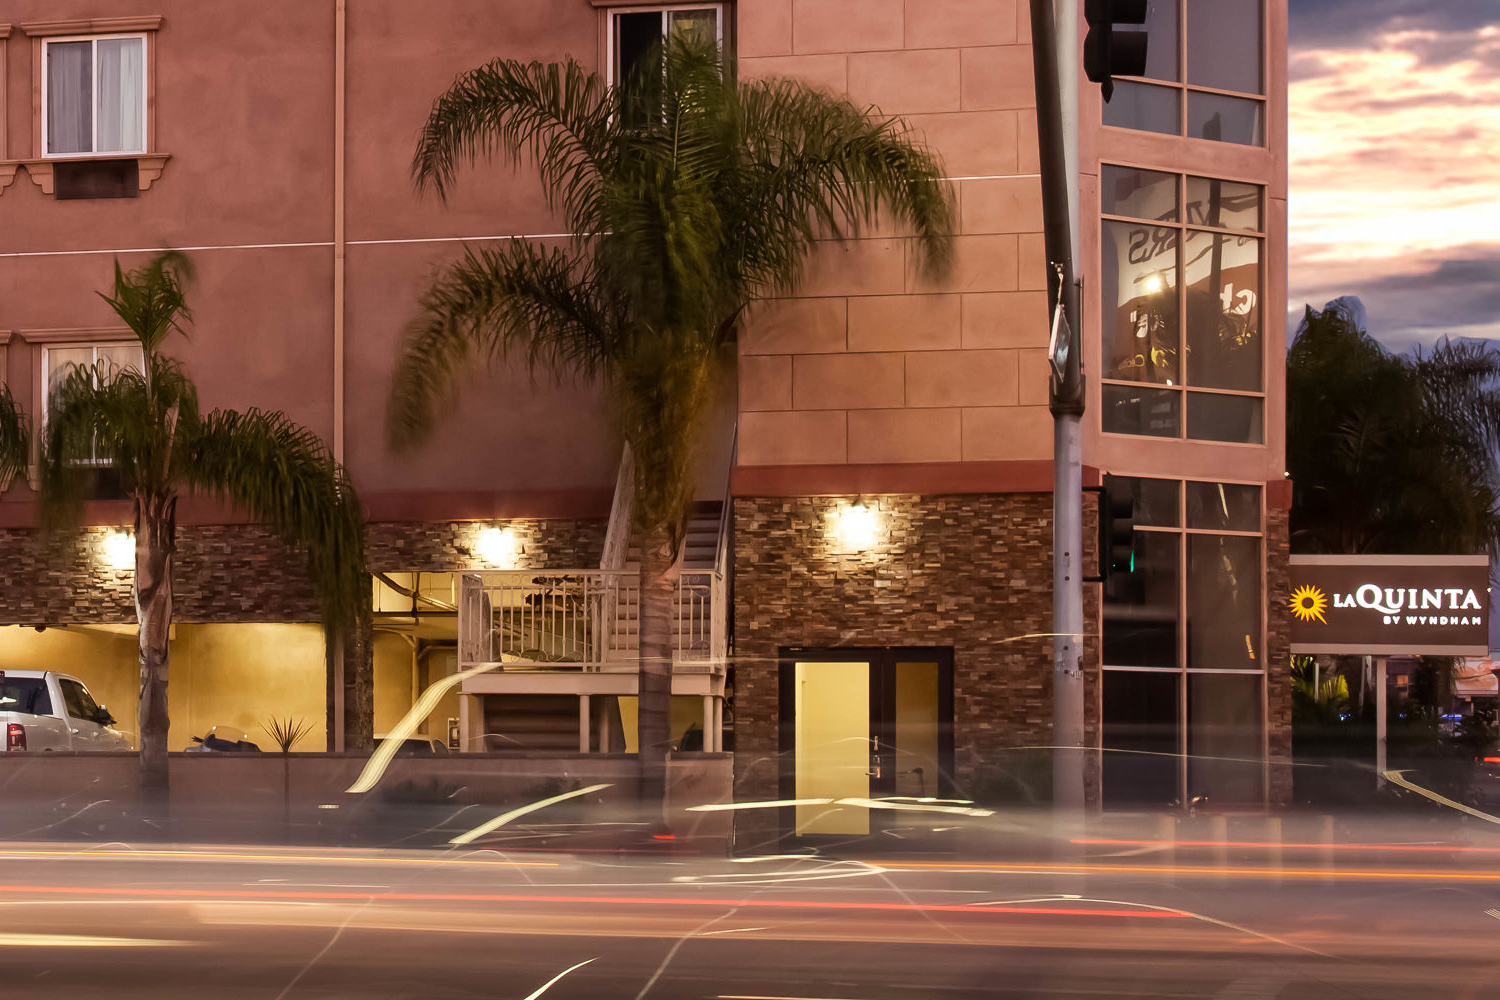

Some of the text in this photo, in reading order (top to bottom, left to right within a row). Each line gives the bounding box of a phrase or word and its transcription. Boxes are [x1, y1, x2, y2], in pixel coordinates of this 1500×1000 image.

[1356, 584, 1482, 614] QUINTA
[1383, 615, 1482, 626] BY WYNDHAM
